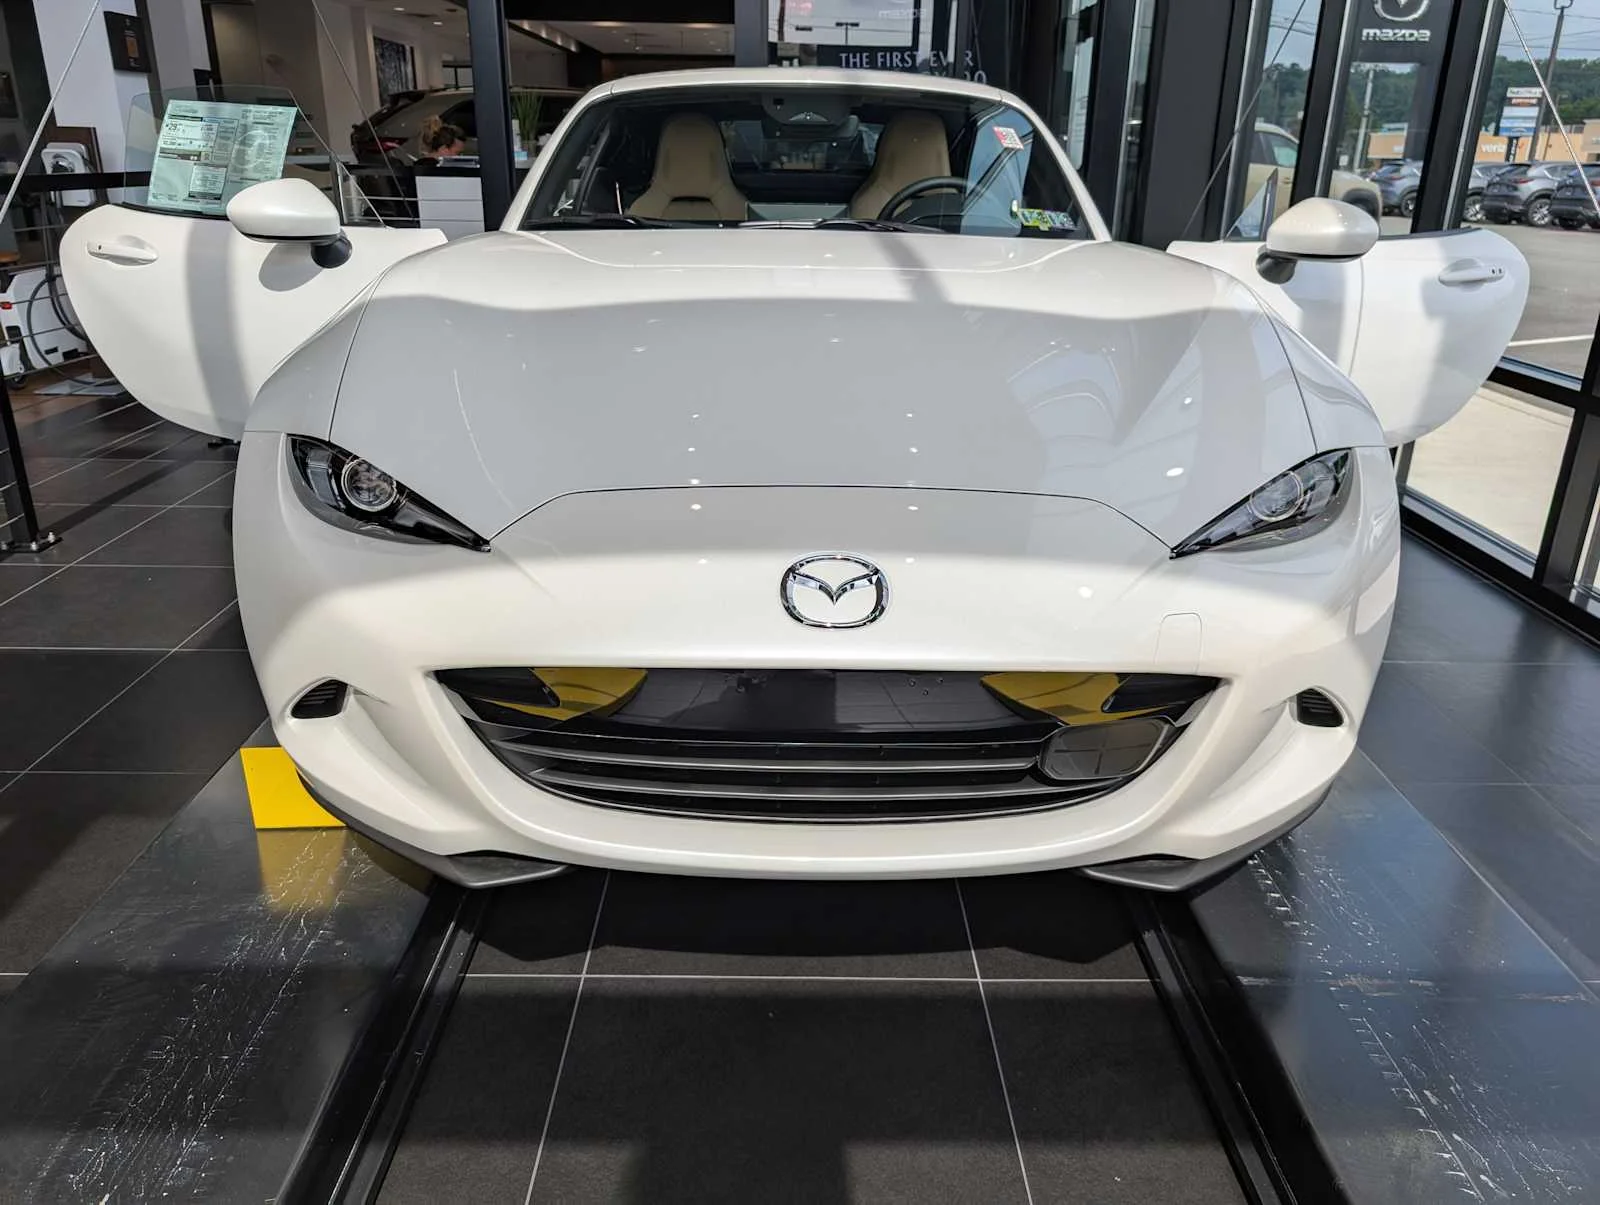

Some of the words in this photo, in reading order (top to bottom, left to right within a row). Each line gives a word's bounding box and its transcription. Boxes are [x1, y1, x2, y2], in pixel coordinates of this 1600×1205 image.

[1361, 28, 1431, 42] mazda
[839, 52, 870, 69] THE
[877, 50, 920, 68] FIRST
[930, 50, 974, 68] EVR
